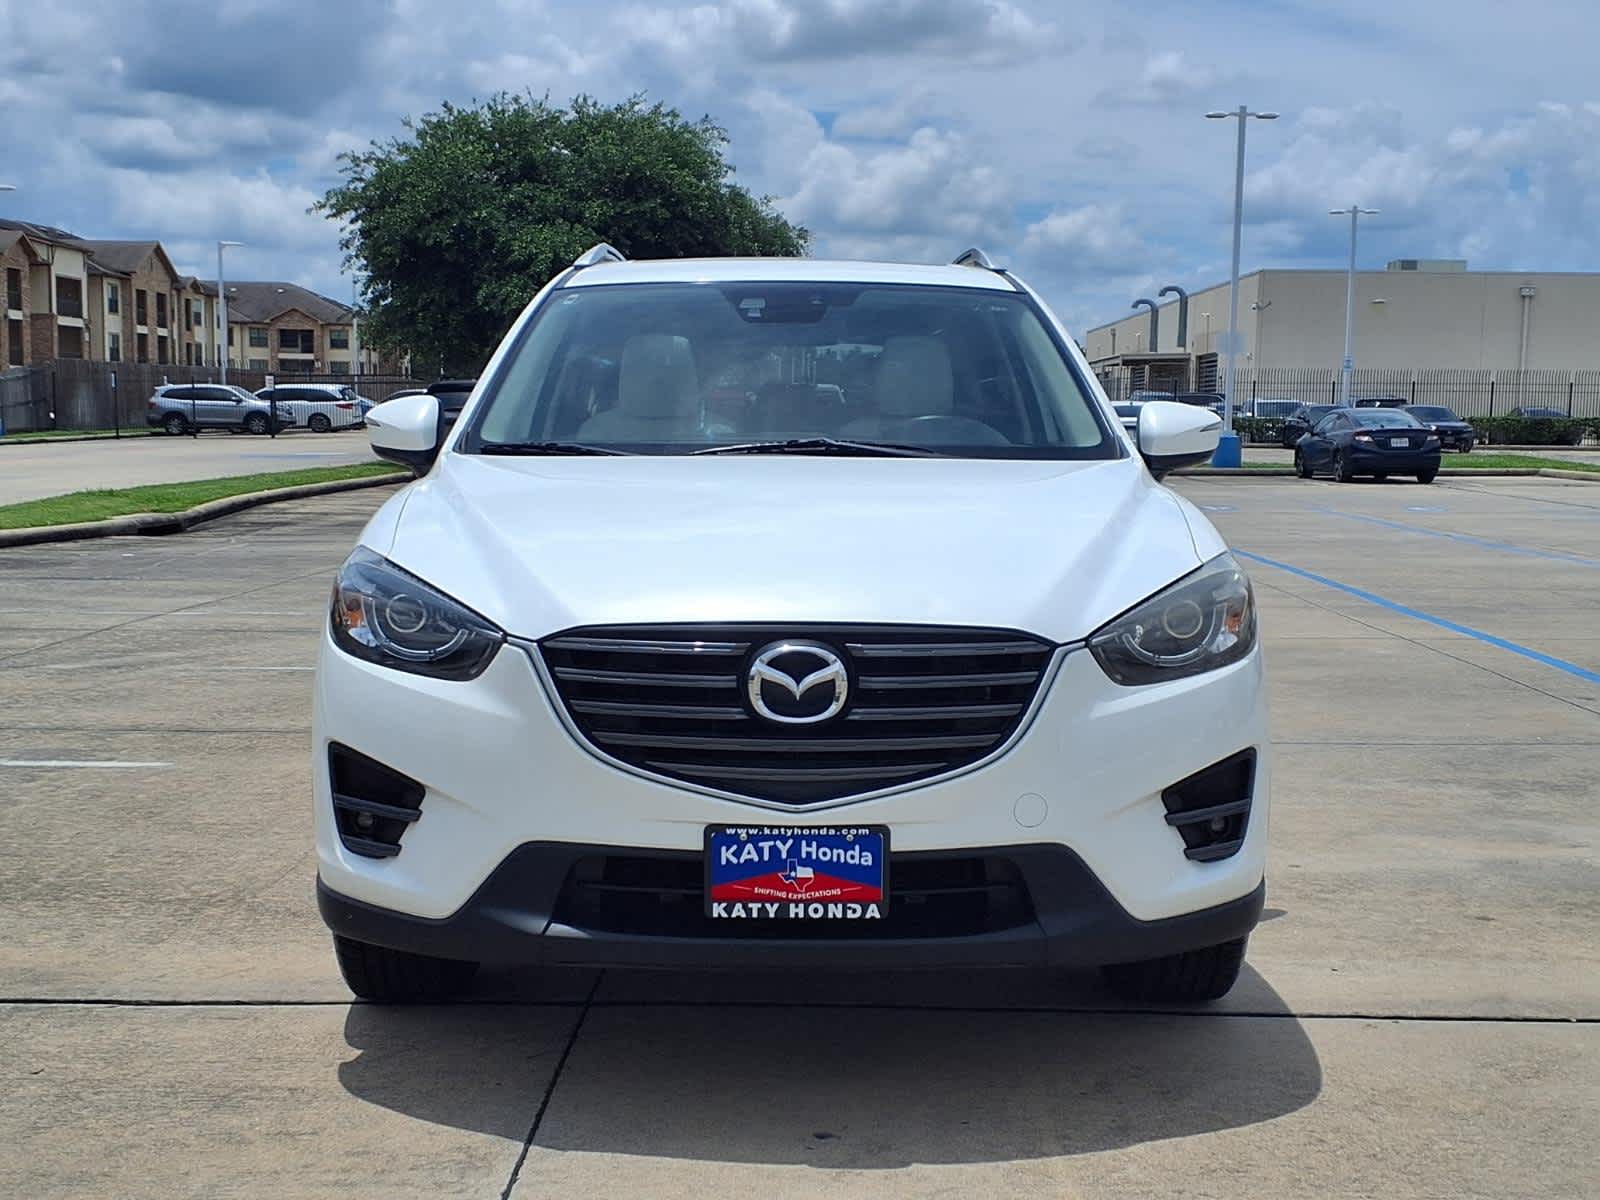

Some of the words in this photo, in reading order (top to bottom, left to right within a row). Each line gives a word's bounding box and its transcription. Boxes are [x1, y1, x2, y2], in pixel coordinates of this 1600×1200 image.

[726, 827, 869, 837] www.katyhonda.com
[720, 839, 794, 865] KATY
[801, 839, 873, 866] Honda
[753, 887, 787, 899] SHIFTING
[788, 887, 841, 900] EXPECTATIONS
[712, 902, 780, 919] KATY
[789, 902, 881, 919] HONDA
